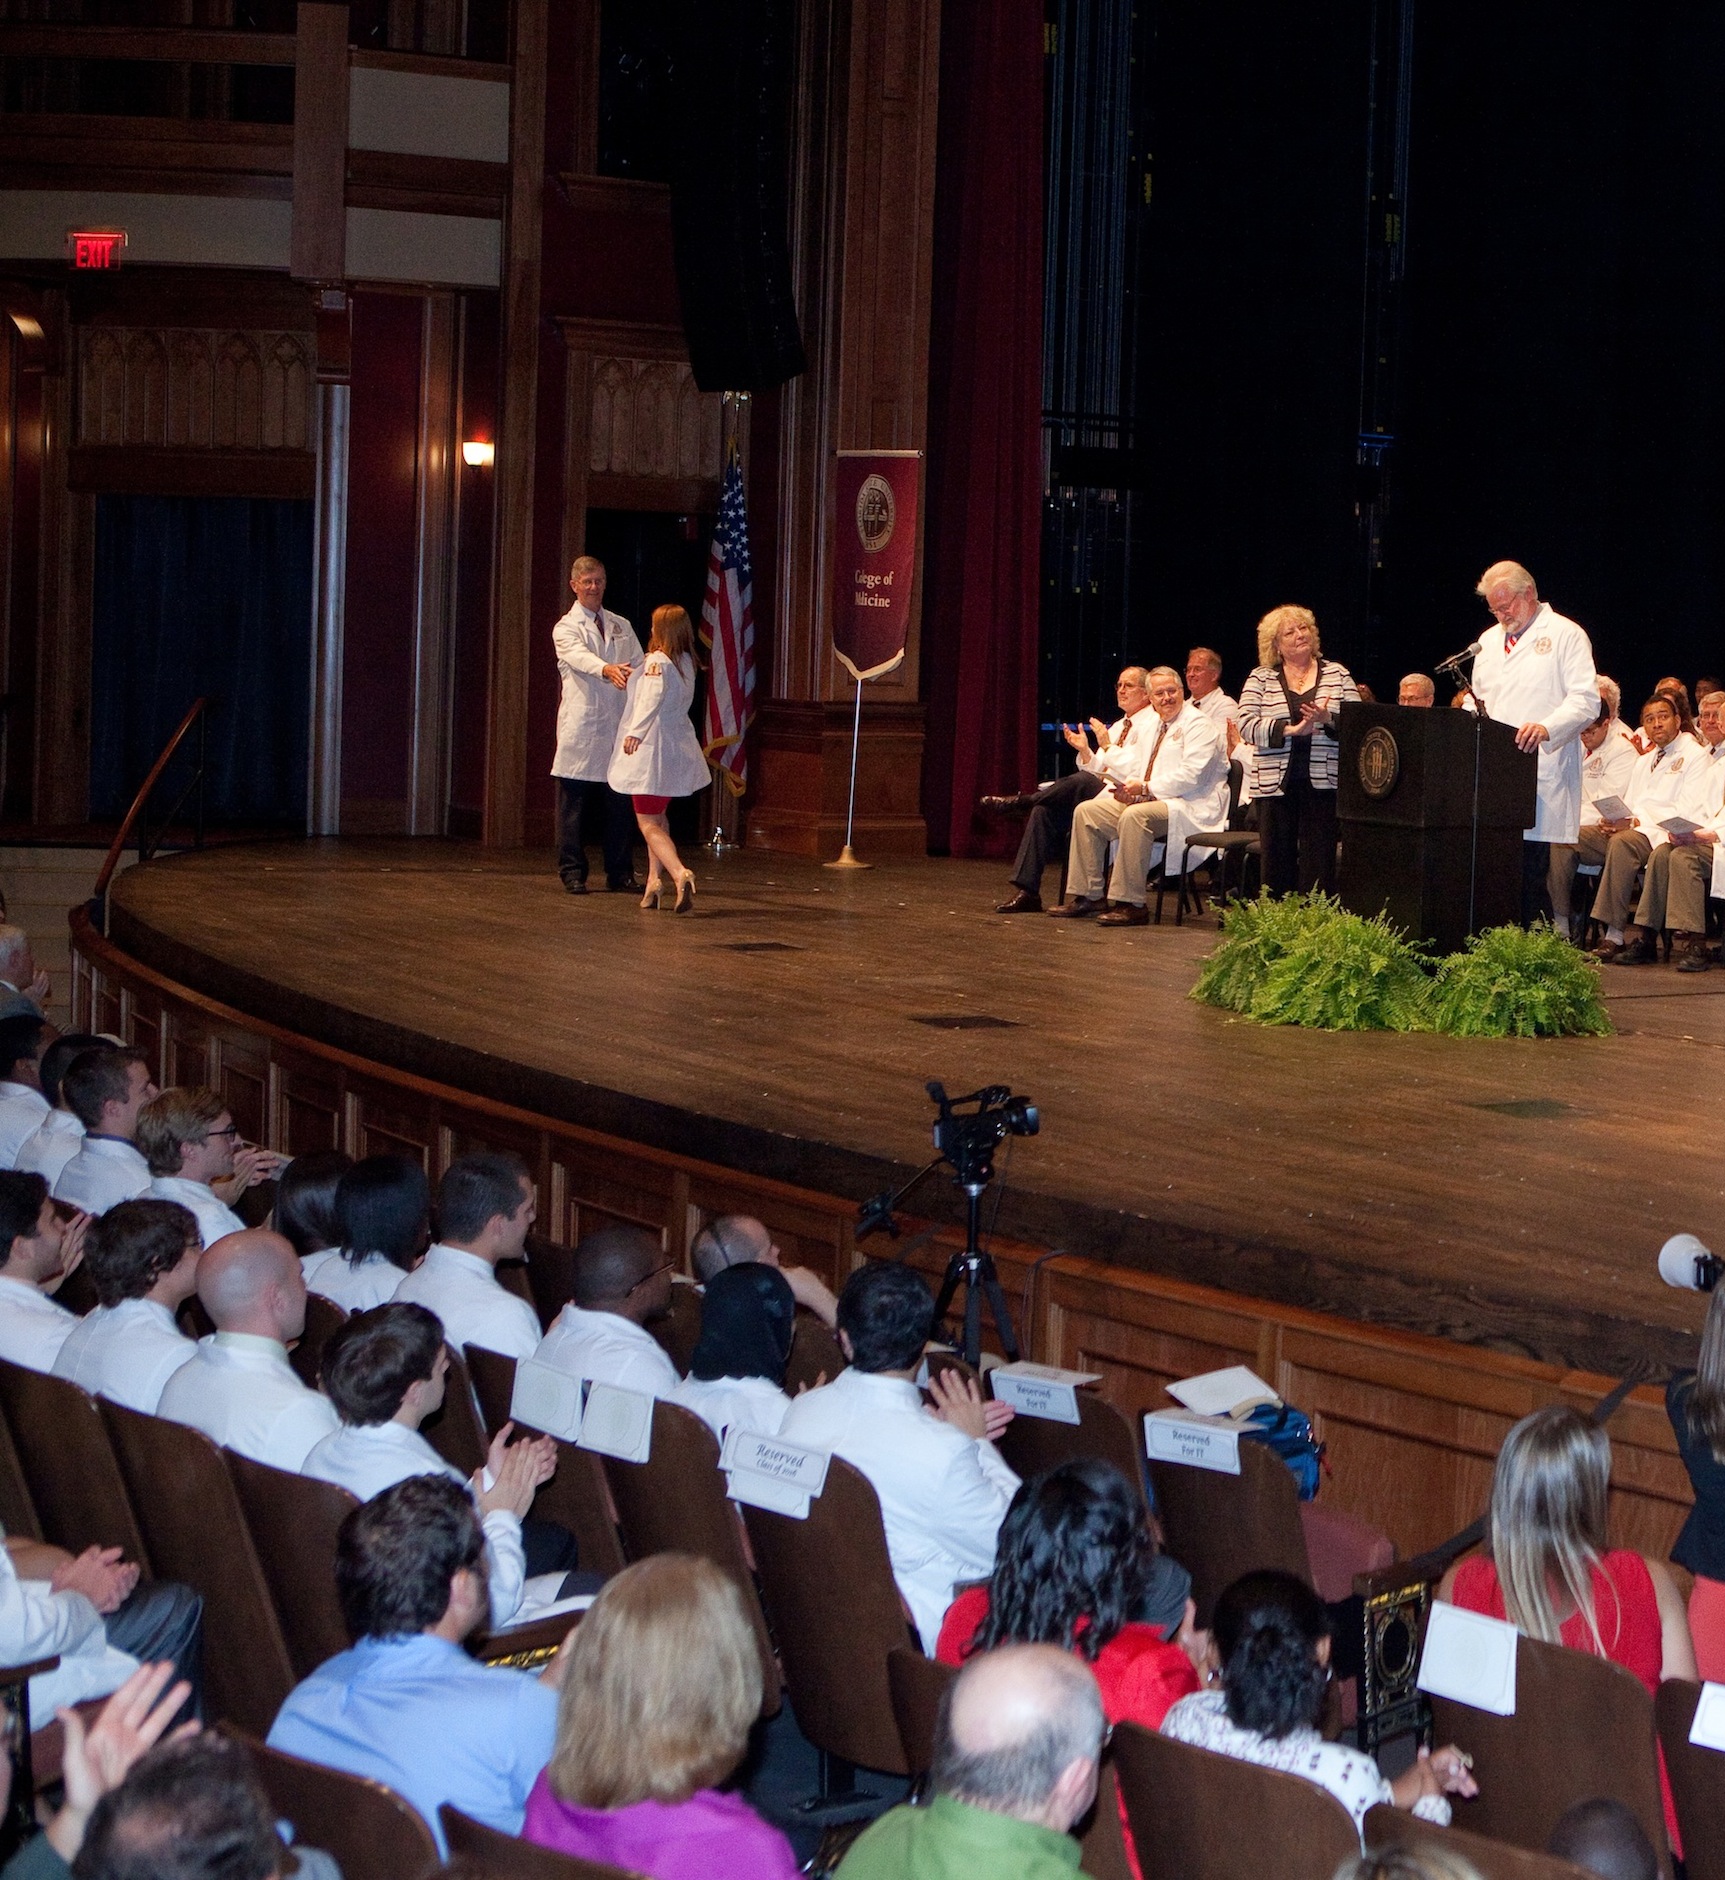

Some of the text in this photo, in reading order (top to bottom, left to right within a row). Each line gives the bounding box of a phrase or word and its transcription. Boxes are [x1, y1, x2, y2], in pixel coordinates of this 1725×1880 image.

[76, 240, 113, 268] EXIT
[854, 569, 894, 589] Colege of
[854, 591, 891, 608] Mdicine
[1015, 1383, 1051, 1398] Reserved
[1172, 1430, 1211, 1446] Reserved
[756, 1443, 808, 1468] Reserved
[773, 1464, 782, 1477] of
